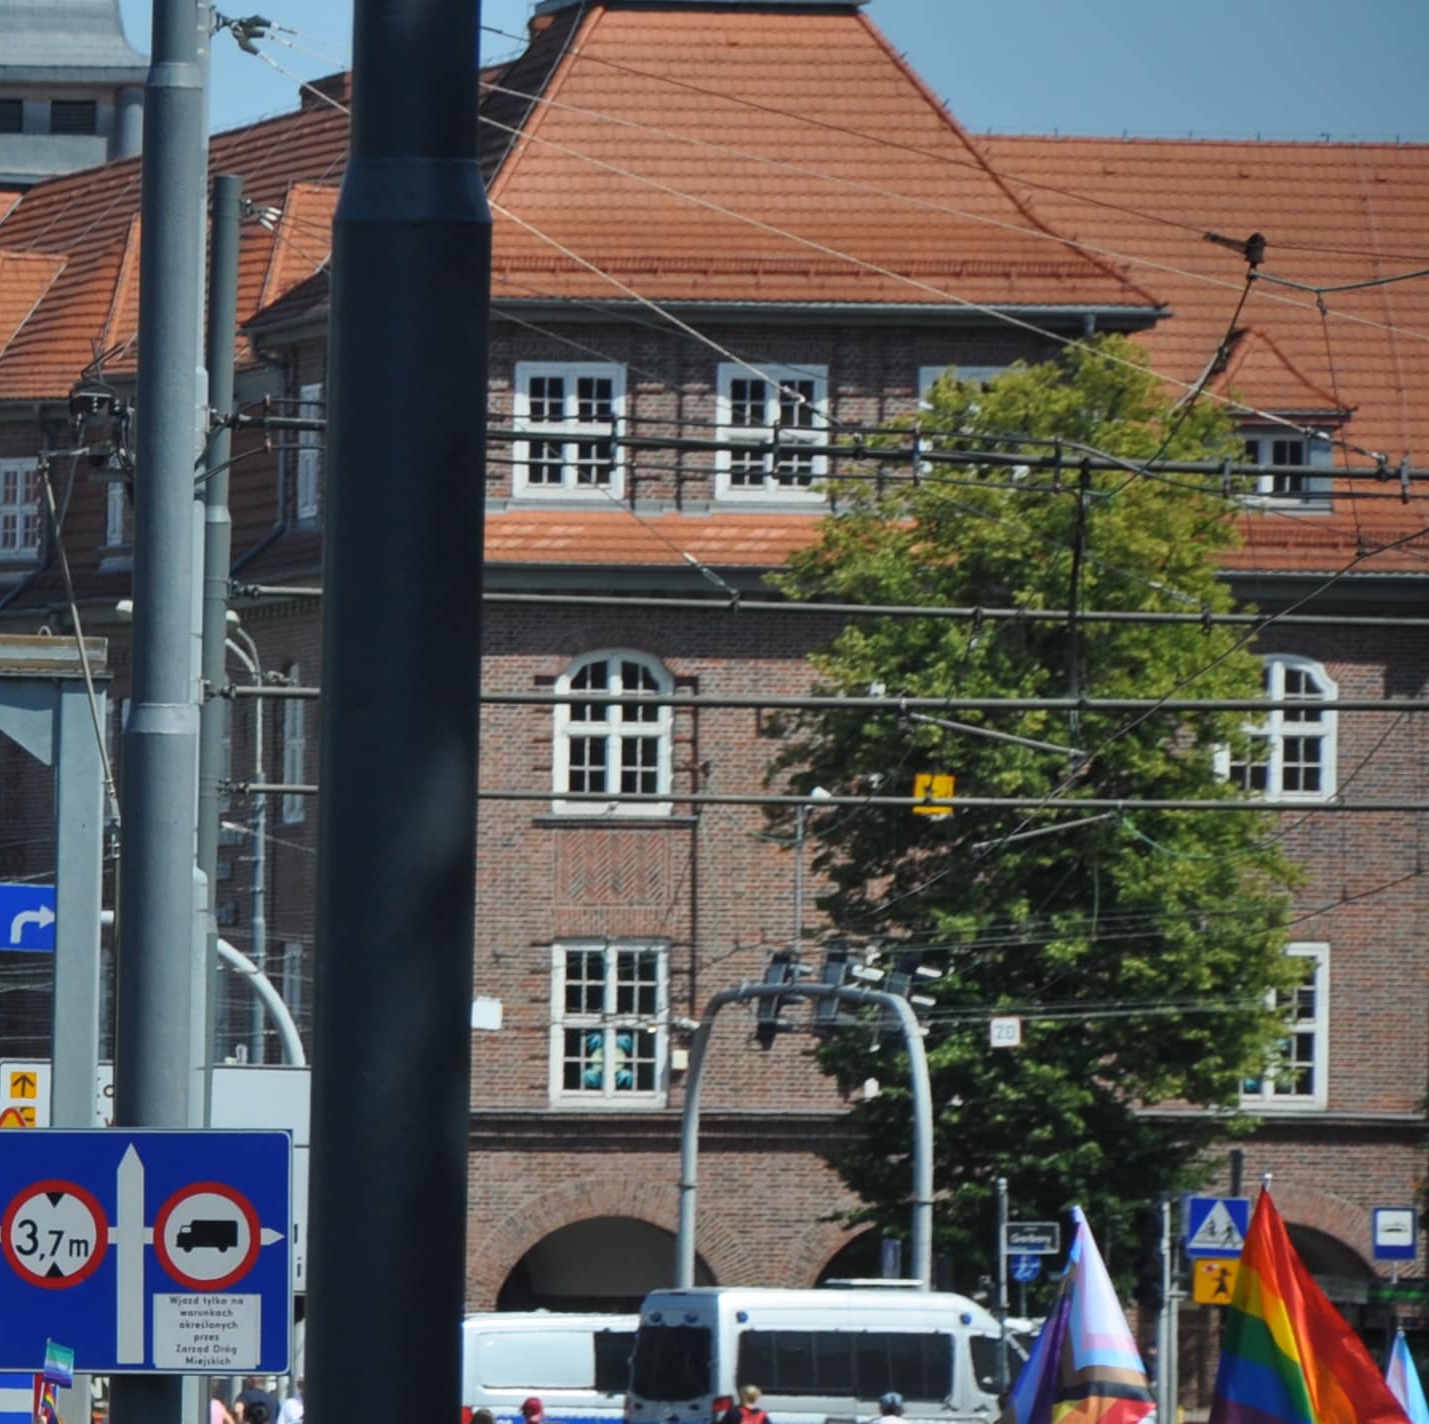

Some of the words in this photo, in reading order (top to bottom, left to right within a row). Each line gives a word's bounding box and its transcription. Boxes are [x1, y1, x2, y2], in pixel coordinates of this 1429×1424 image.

[169, 1296, 199, 1307] Wjazd
[203, 1296, 228, 1307] tylko
[231, 1297, 244, 1305] na
[179, 1309, 234, 1317] warunkach
[193, 1333, 220, 1343] przez
[212, 1343, 238, 1356] Dróg
[185, 1356, 232, 1367] Miejskich
